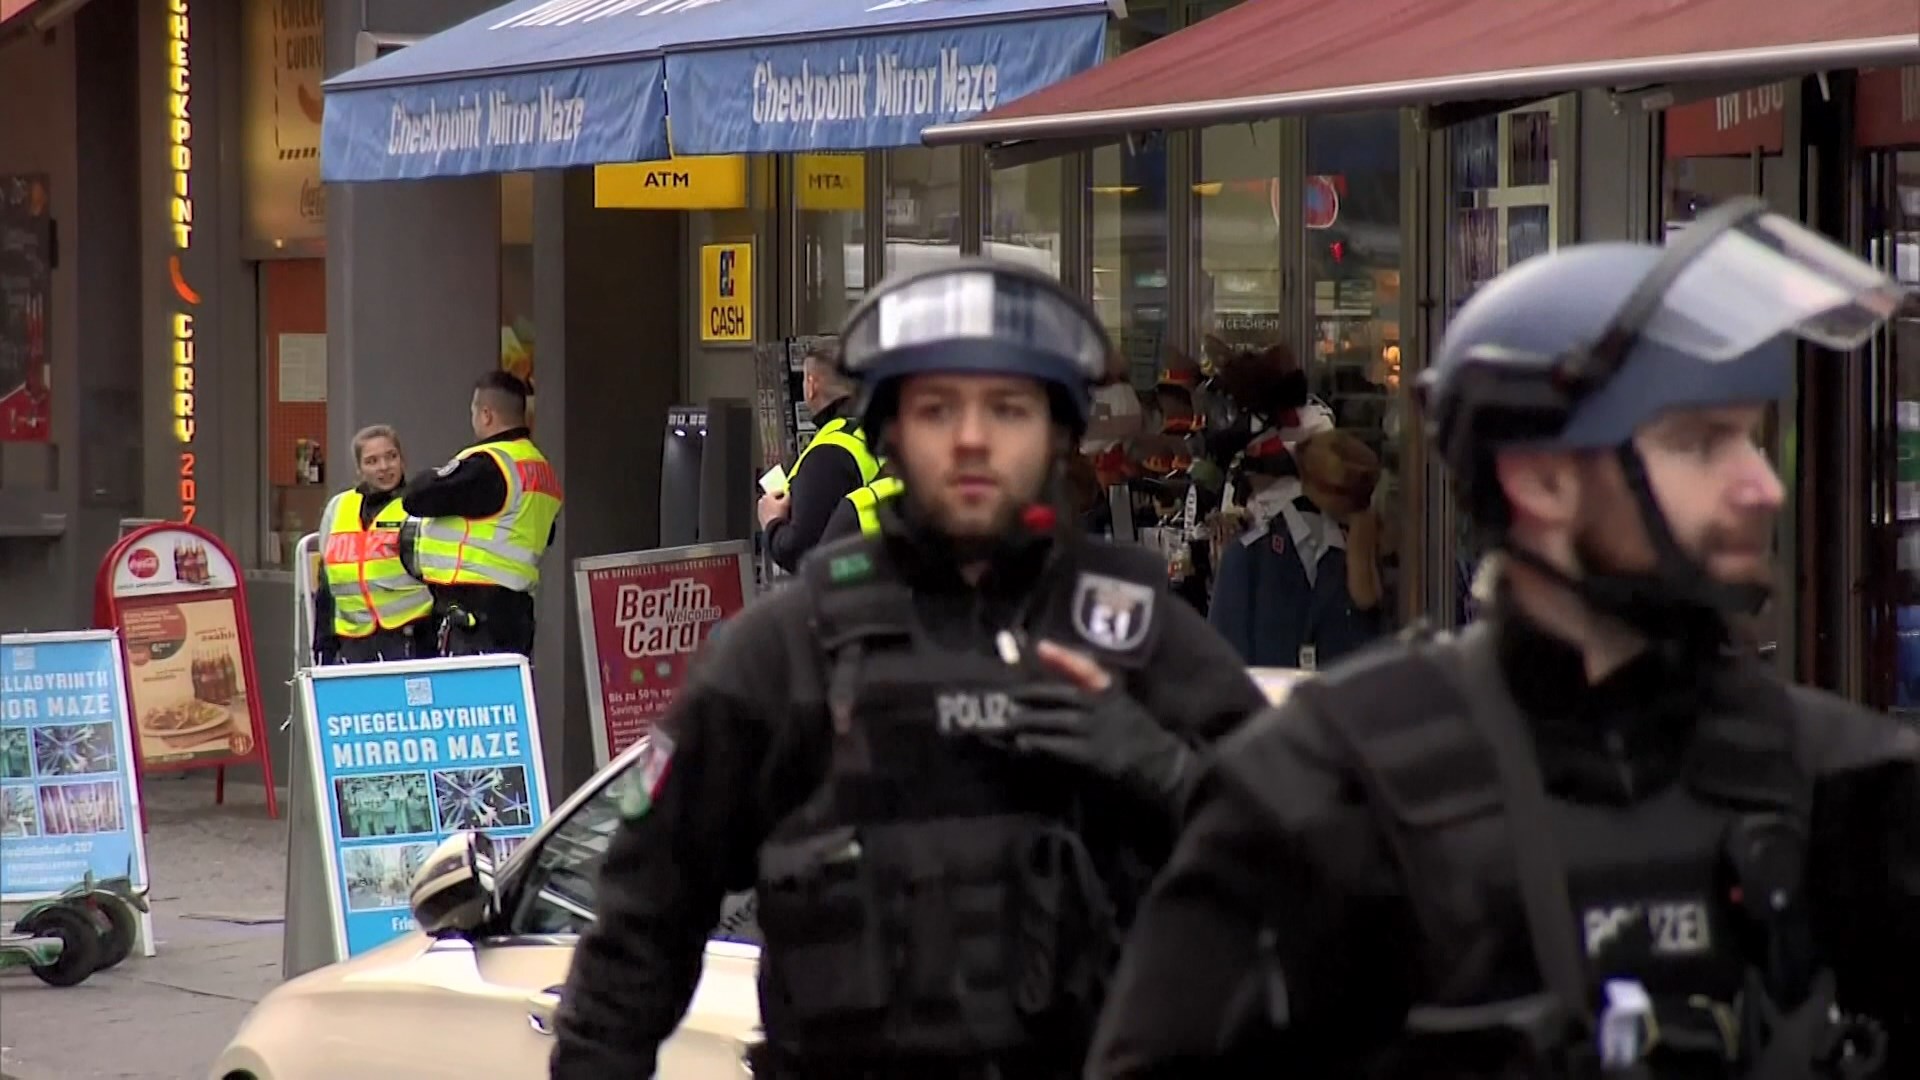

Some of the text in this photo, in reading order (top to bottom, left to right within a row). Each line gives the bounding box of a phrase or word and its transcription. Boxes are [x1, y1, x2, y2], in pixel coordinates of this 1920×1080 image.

[752, 47, 997, 137] Checkpoint Mirror Maze
[388, 85, 585, 166] Checkpoint Mirror Maze
[644, 172, 690, 188] ATM
[711, 306, 745, 336] CASH
[173, 313, 195, 442] CURRY
[180, 452, 196, 525] 207
[617, 580, 709, 624] Berlin
[665, 605, 722, 625] Welcome
[625, 620, 700, 656] Card
[0, 671, 109, 692] LLABYRINTH
[608, 690, 623, 703] Bis
[0, 692, 112, 720] OR MAZE
[327, 704, 517, 737] SPIEGELLABYRINTH
[332, 731, 520, 769] MIRROR MAZE
